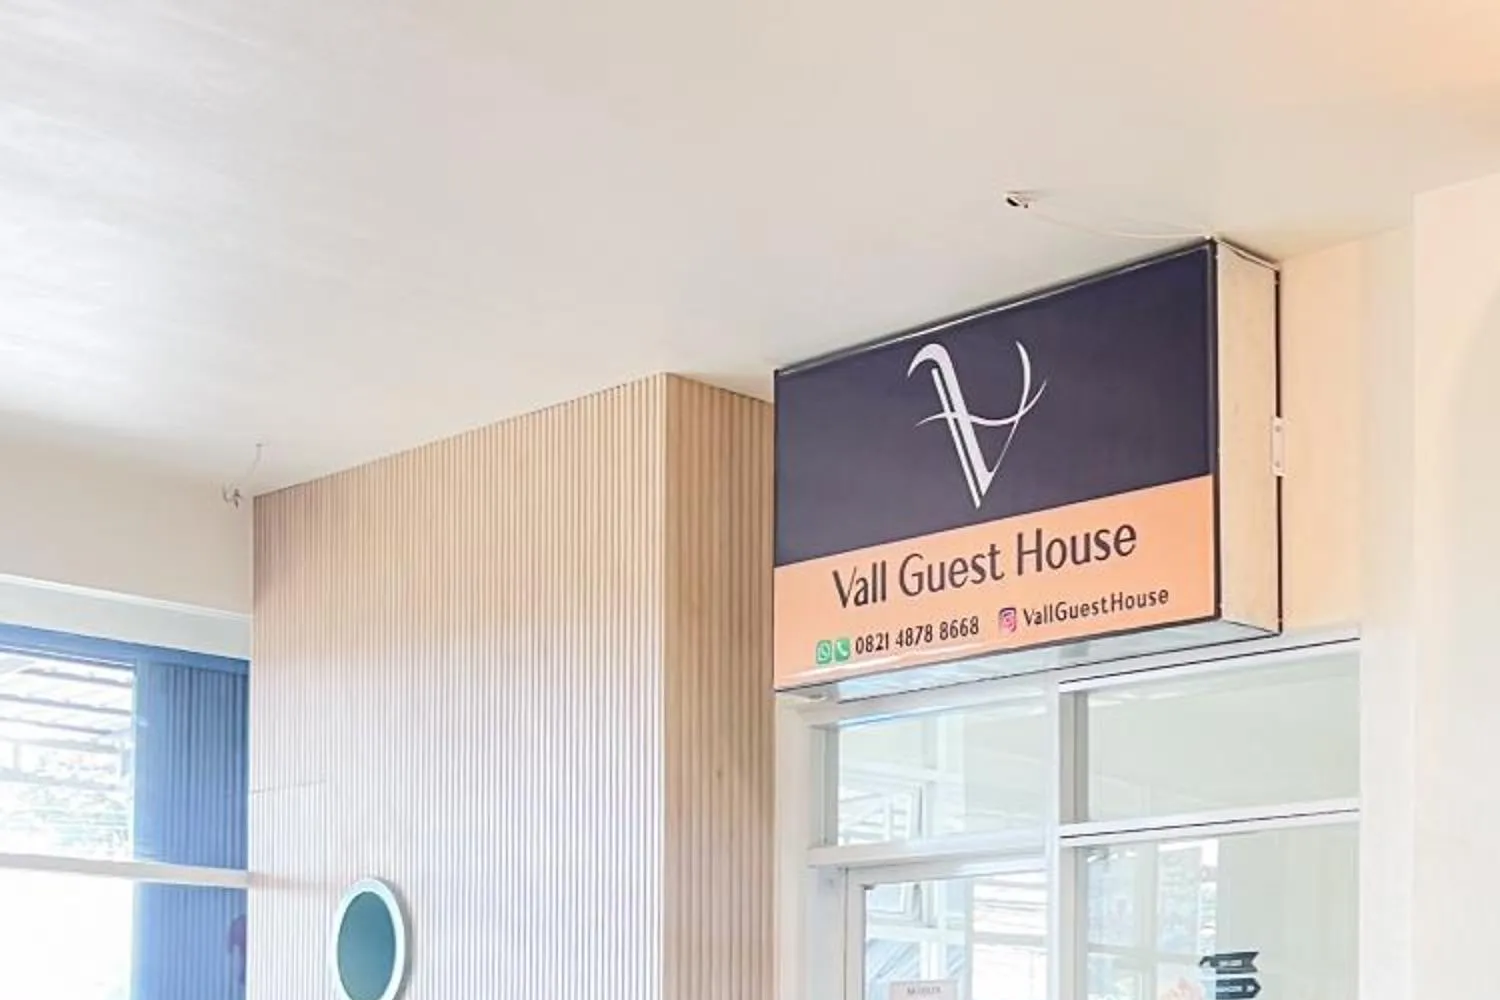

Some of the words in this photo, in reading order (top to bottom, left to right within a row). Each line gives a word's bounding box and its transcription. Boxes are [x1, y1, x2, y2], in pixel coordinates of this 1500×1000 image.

[832, 560, 887, 609] Vall
[899, 543, 1005, 597] Guest
[1017, 523, 1137, 576] House
[855, 631, 890, 655] 0821
[895, 623, 934, 648] 4878
[939, 615, 980, 641] 8668
[1023, 587, 1169, 627] VallGuestHouse
